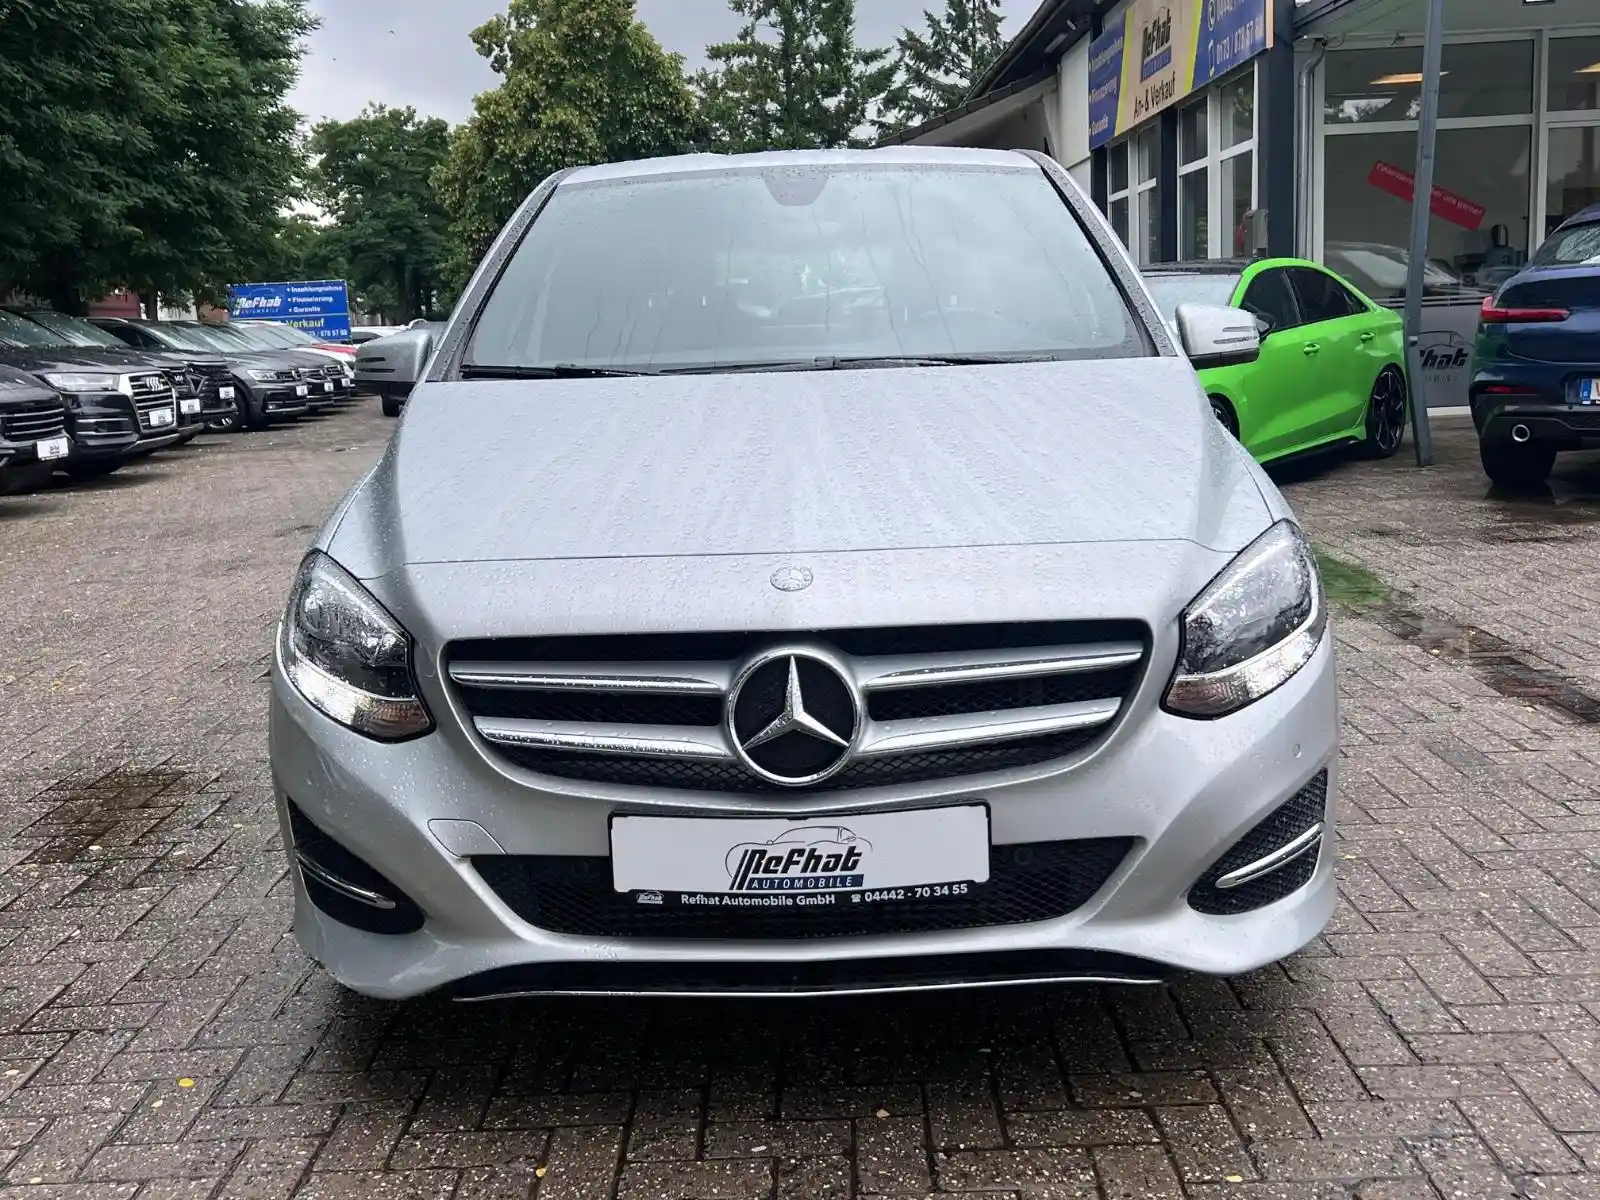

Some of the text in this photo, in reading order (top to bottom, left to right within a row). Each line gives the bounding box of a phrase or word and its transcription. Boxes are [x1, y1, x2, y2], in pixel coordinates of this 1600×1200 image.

[1151, 70, 1176, 108] Verkauf
[286, 318, 325, 328] Verkauf
[751, 876, 853, 889] AUTOMOBILE
[681, 894, 720, 905] Refhat
[722, 895, 793, 906] Automobile
[796, 894, 835, 905] GmbH
[864, 889, 905, 902] 04442
[914, 886, 931, 898] 70
[933, 885, 949, 895] 34
[952, 883, 968, 894] 55
